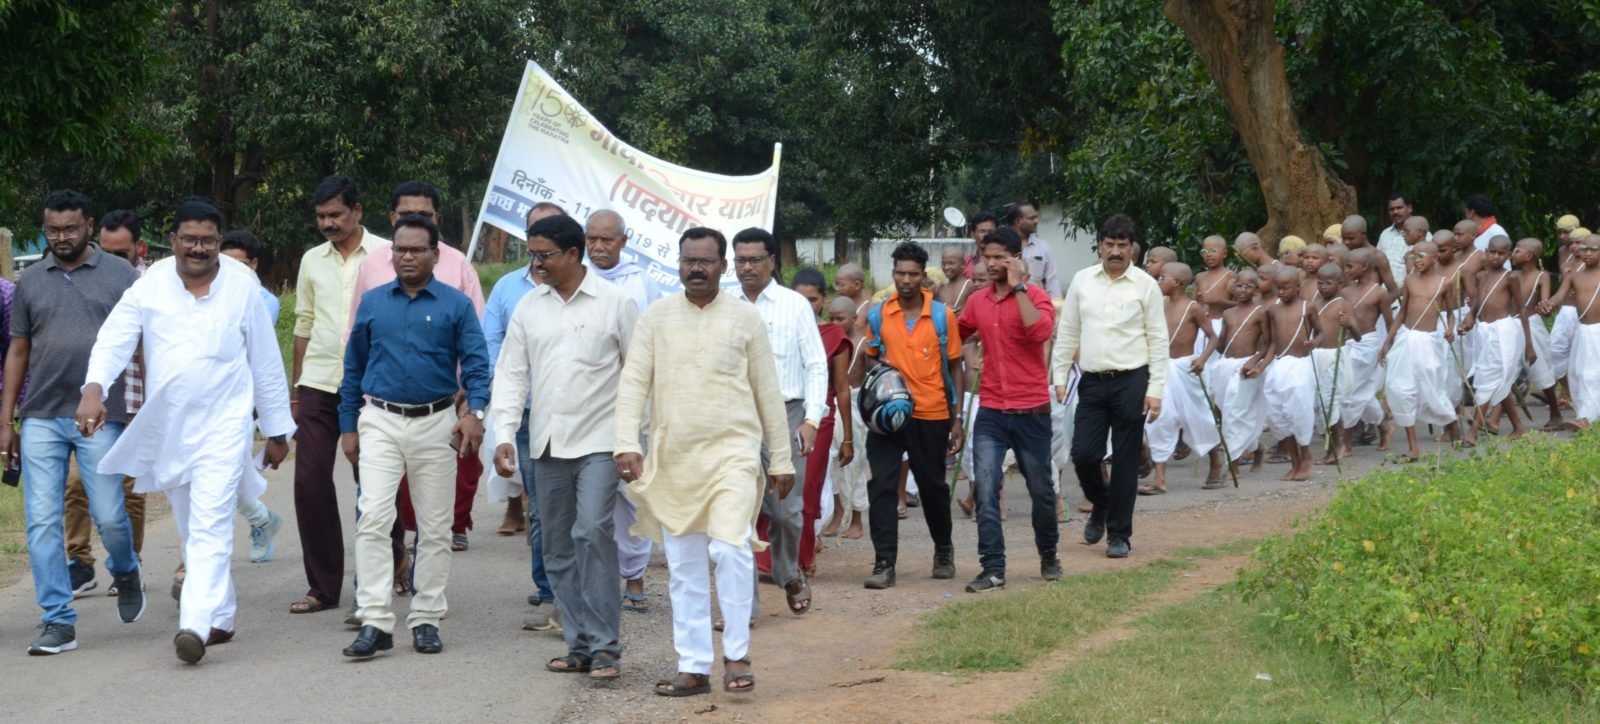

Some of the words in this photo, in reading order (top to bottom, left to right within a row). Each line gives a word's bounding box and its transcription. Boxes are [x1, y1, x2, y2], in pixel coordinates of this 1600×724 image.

[529, 118, 570, 138] CELEBRATING
[532, 113, 553, 125] YEARS
[528, 123, 540, 132] THE
[540, 128, 570, 145] MAHATMA
[488, 191, 517, 212] वच्छ
[510, 169, 556, 200] दिनाँक
[574, 202, 592, 218] 11
[625, 227, 653, 249] 019
[718, 193, 765, 220] यात्रा
